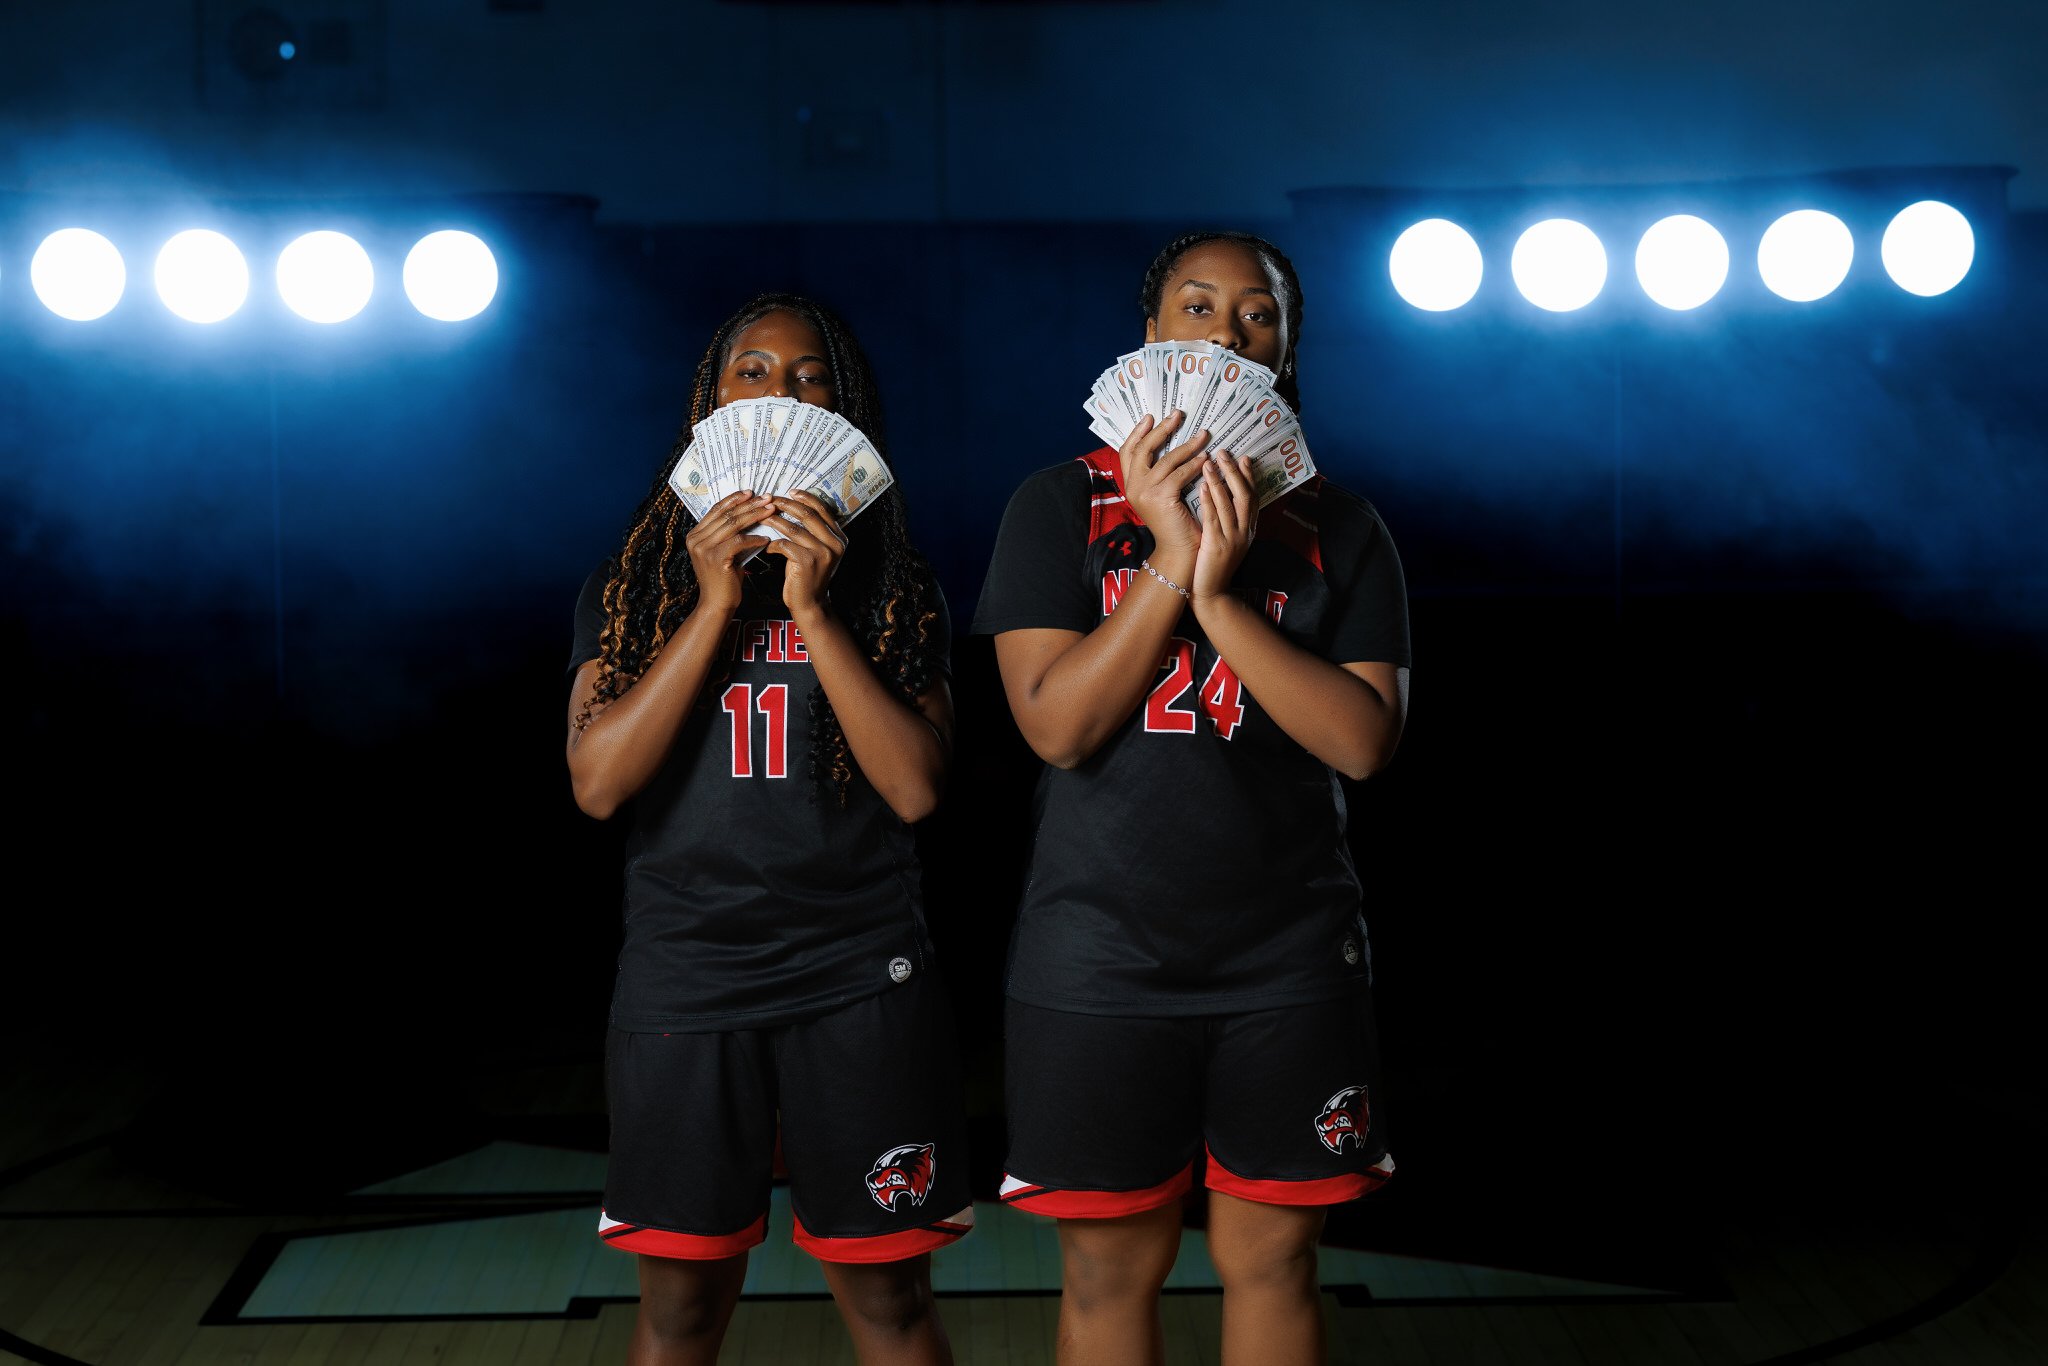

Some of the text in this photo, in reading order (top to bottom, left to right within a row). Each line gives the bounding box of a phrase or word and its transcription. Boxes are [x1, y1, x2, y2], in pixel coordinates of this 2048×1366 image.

[1280, 439, 1304, 479] 100
[721, 682, 788, 779] 11
[1144, 636, 1246, 742] 24
